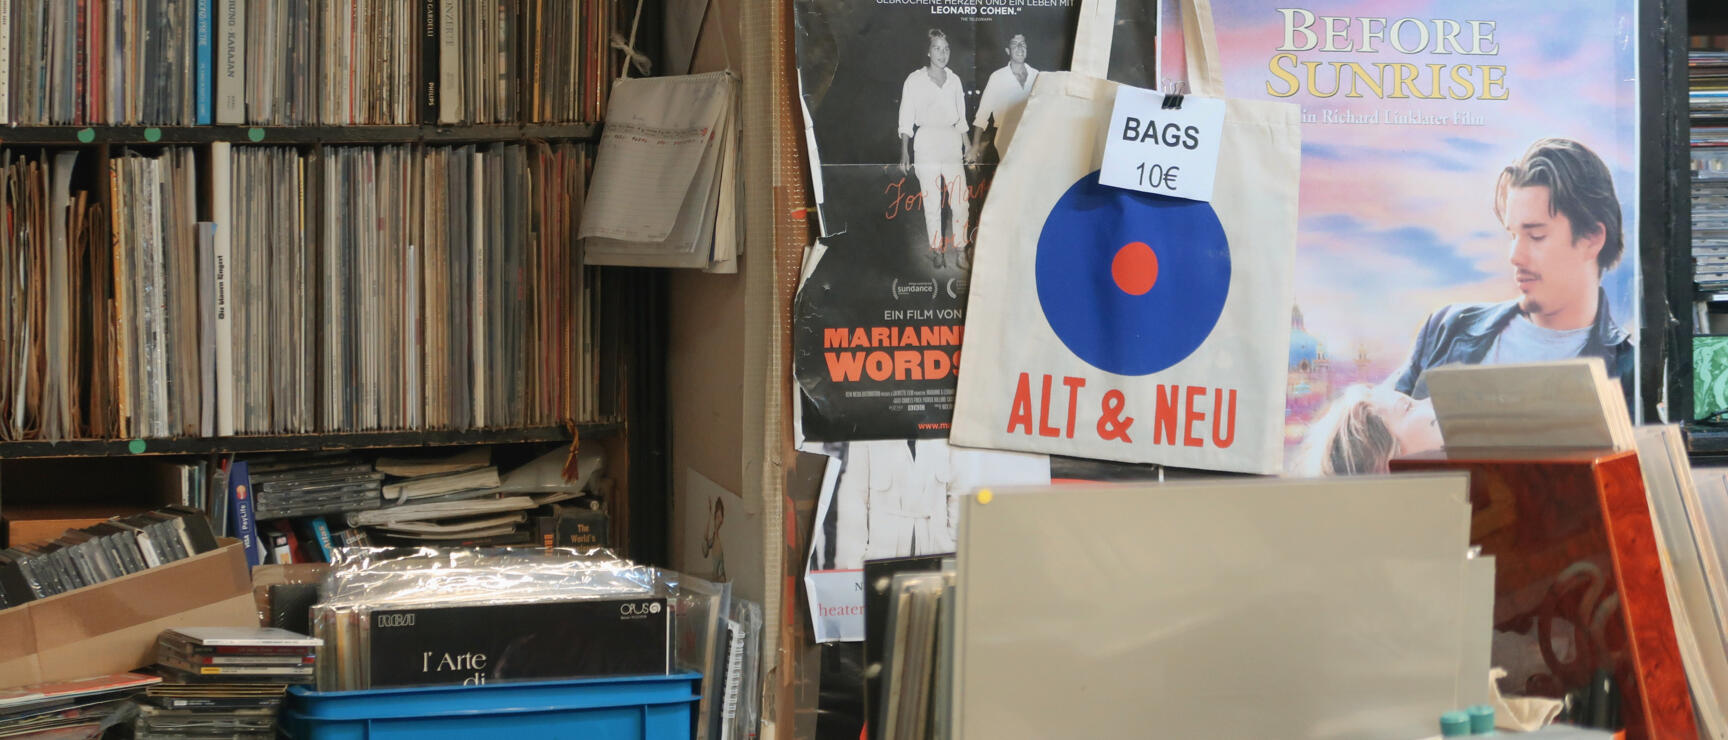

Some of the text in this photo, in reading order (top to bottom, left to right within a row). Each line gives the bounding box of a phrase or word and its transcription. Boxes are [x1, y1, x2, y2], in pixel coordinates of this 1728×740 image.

[931, 6, 977, 15] LEONARD
[1275, 7, 1500, 56] BEFORE
[227, 32, 236, 78] KARAJAN
[1265, 53, 1510, 100] SUNRISE
[1301, 109, 1486, 126] in Richard Linklater Film
[1122, 116, 1200, 150] BAGS
[1136, 162, 1180, 190] 10€
[884, 173, 991, 220] For Mar
[884, 309, 962, 320] EIN FILM VON
[1007, 372, 1237, 448] ALT & NEU
[577, 524, 590, 533] The
[378, 613, 415, 627] RCA
[620, 603, 649, 616] OPUS
[436, 651, 487, 672] Arte
